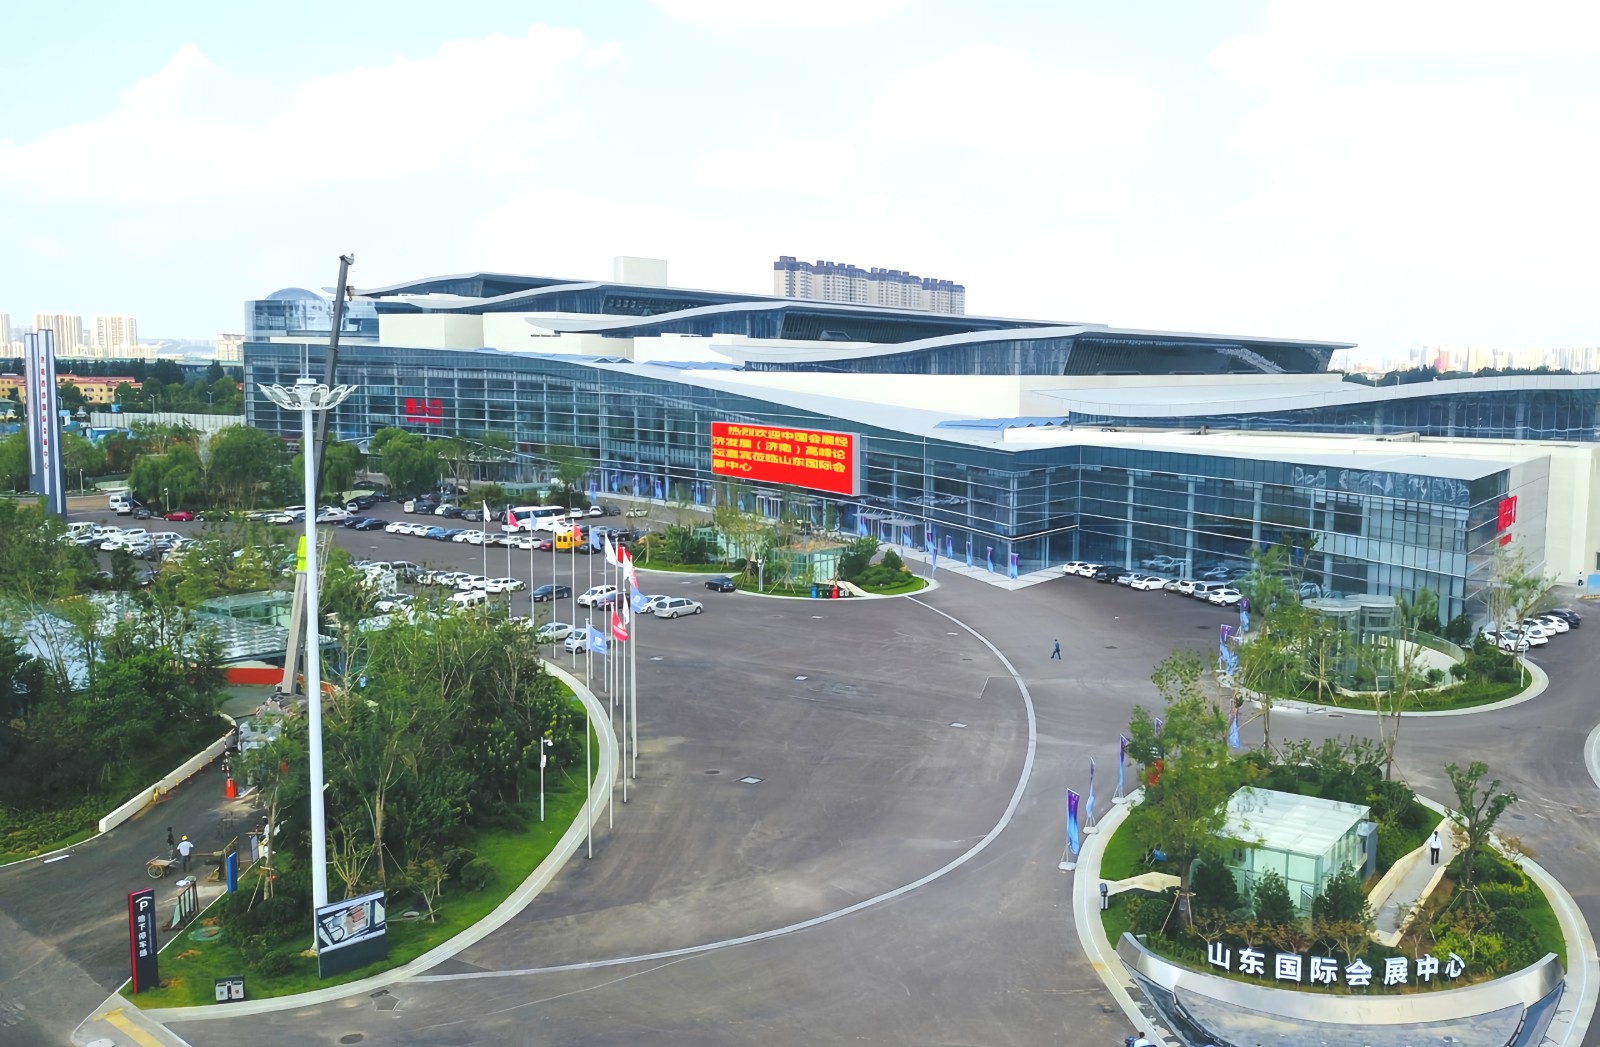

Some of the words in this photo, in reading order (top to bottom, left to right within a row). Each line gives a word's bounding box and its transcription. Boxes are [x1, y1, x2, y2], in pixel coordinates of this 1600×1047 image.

[728, 426, 848, 447] 热烈欢迎中国会展经
[712, 447, 846, 473] 坛嘉宾莅临山东国际会
[712, 458, 752, 472] 展中心
[139, 900, 149, 912] P
[1207, 942, 1466, 986] 山东国际会展中心
